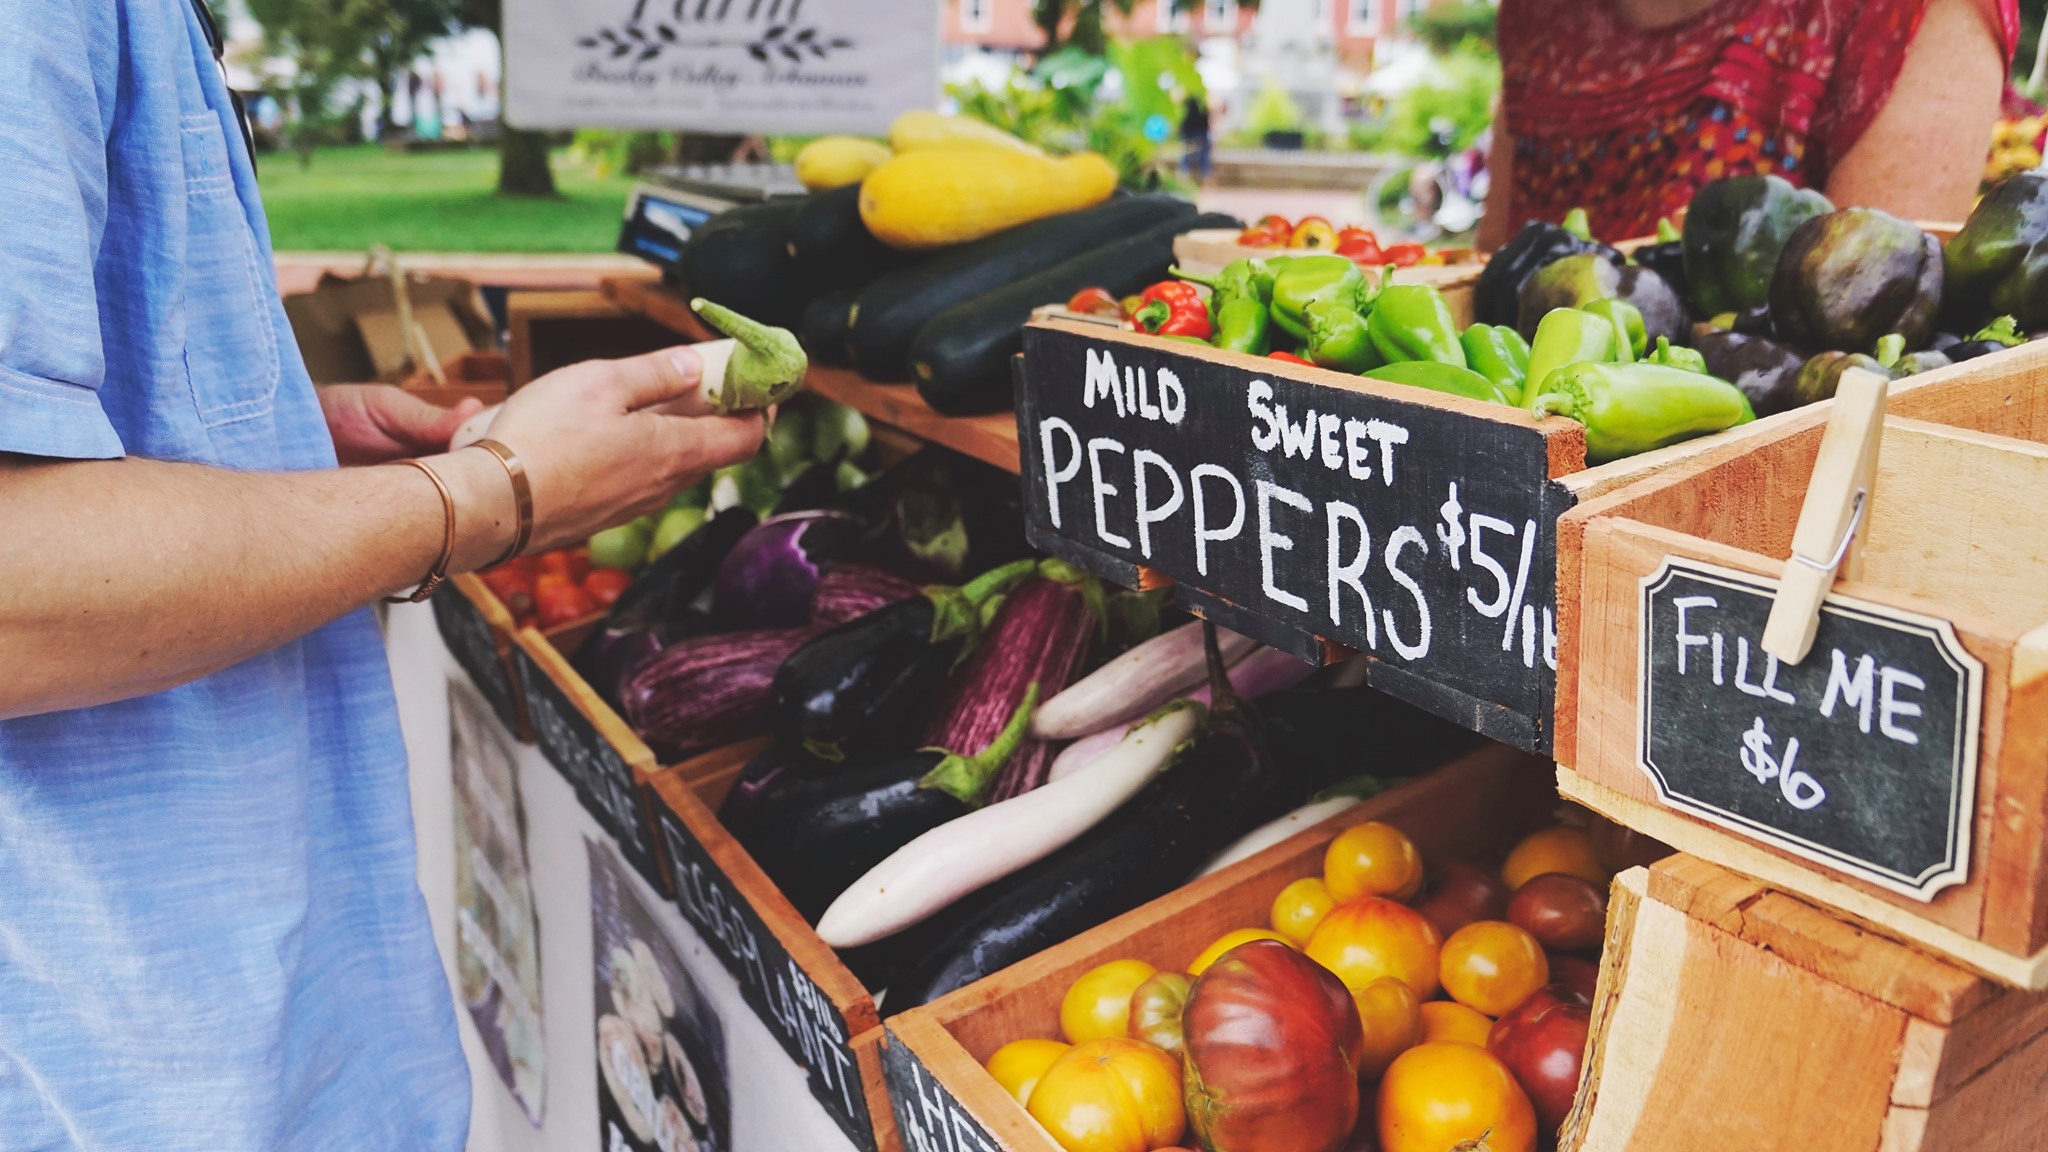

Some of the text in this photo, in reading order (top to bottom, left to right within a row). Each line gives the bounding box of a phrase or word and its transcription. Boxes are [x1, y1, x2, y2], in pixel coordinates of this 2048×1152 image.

[1083, 347, 1409, 486] MILD SWEET
[1039, 416, 1430, 661] PEPPERS
[1673, 596, 1926, 745] FILL ME
[1740, 716, 1826, 811] $6
